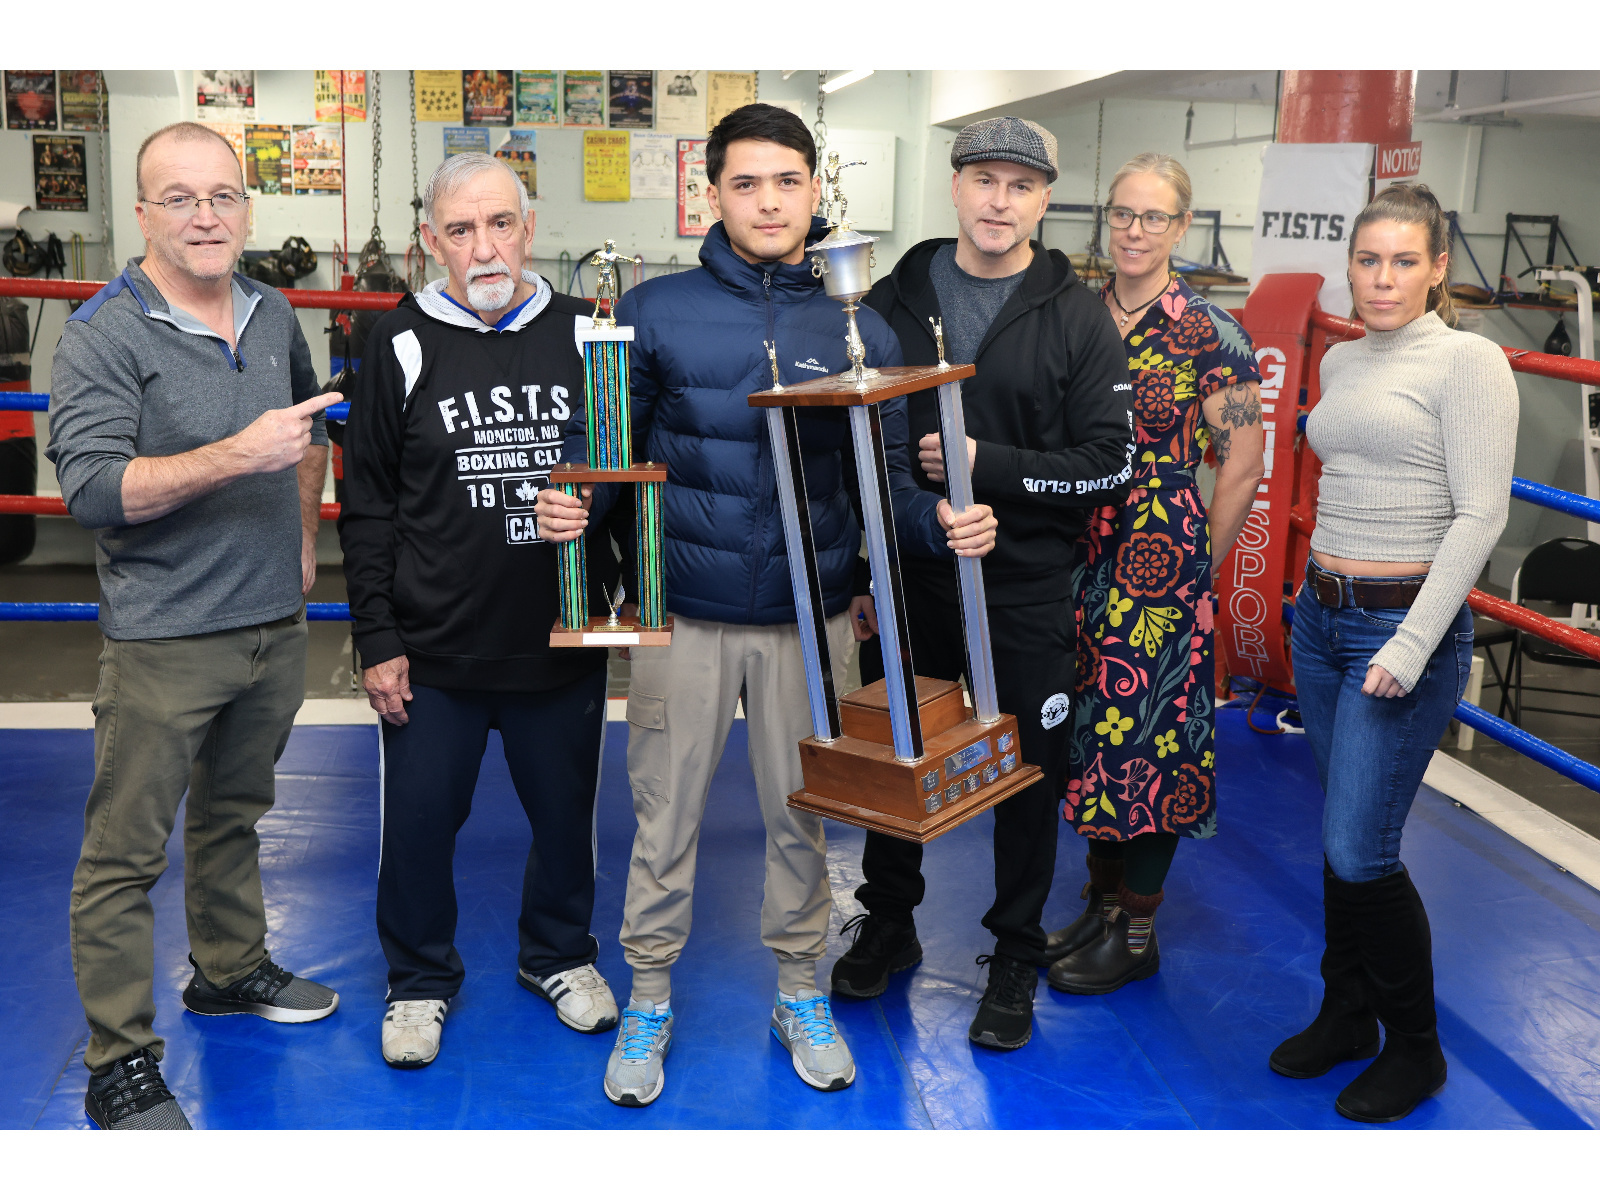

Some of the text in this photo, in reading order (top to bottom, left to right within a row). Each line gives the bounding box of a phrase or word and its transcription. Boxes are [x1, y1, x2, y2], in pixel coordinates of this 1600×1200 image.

[1382, 147, 1420, 174] NOTICE
[795, 361, 829, 373] Kathmandu
[474, 427, 539, 445] MONCTON,
[457, 447, 563, 472] BOXING CL
[466, 483, 496, 508] 19
[1022, 477, 1072, 494] CLUB
